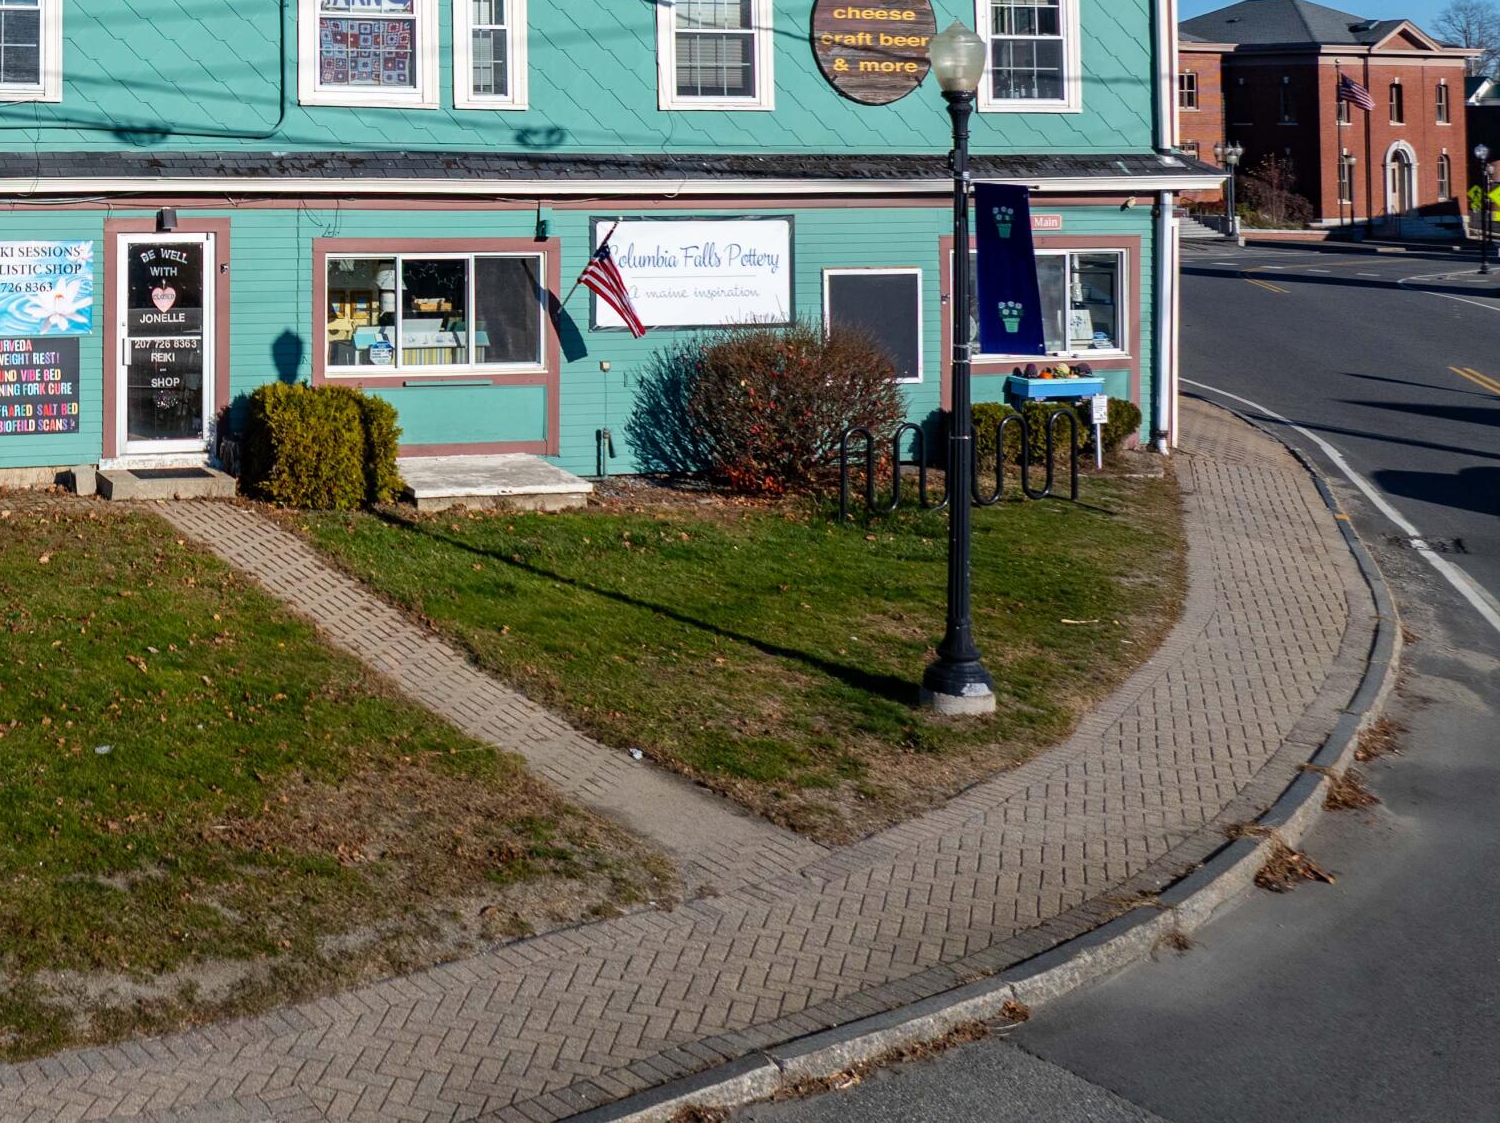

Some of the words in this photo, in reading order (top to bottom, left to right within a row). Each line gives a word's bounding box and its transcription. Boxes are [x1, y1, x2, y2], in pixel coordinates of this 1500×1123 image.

[833, 6, 917, 21] cheese
[821, 32, 873, 46] craft
[879, 33, 930, 47] beer
[833, 58, 849, 72] &
[859, 61, 919, 73] more
[1034, 217, 1058, 227] Main
[18, 246, 81, 258] SESSIONS
[140, 249, 156, 263] BE
[160, 248, 188, 264] WELL
[680, 242, 722, 269] Falls
[724, 243, 780, 274] Pottery
[45, 264, 82, 275] SHOP
[150, 266, 178, 277] WITH
[1, 282, 22, 293] 726
[25, 281, 53, 293] 8363
[645, 288, 687, 300] maine
[694, 286, 760, 302] inspiration
[140, 313, 186, 324] JONELLE
[134, 339, 151, 349] 207
[155, 339, 171, 349] 726
[173, 339, 197, 349] 8363
[150, 352, 175, 363] REIKI
[20, 369, 41, 381] VIBE
[43, 368, 61, 381] BED
[23, 383, 46, 395] FORK
[48, 382, 72, 395] CURE
[151, 377, 180, 388] SHOP
[37, 403, 58, 416] SALT
[61, 402, 78, 415] BED
